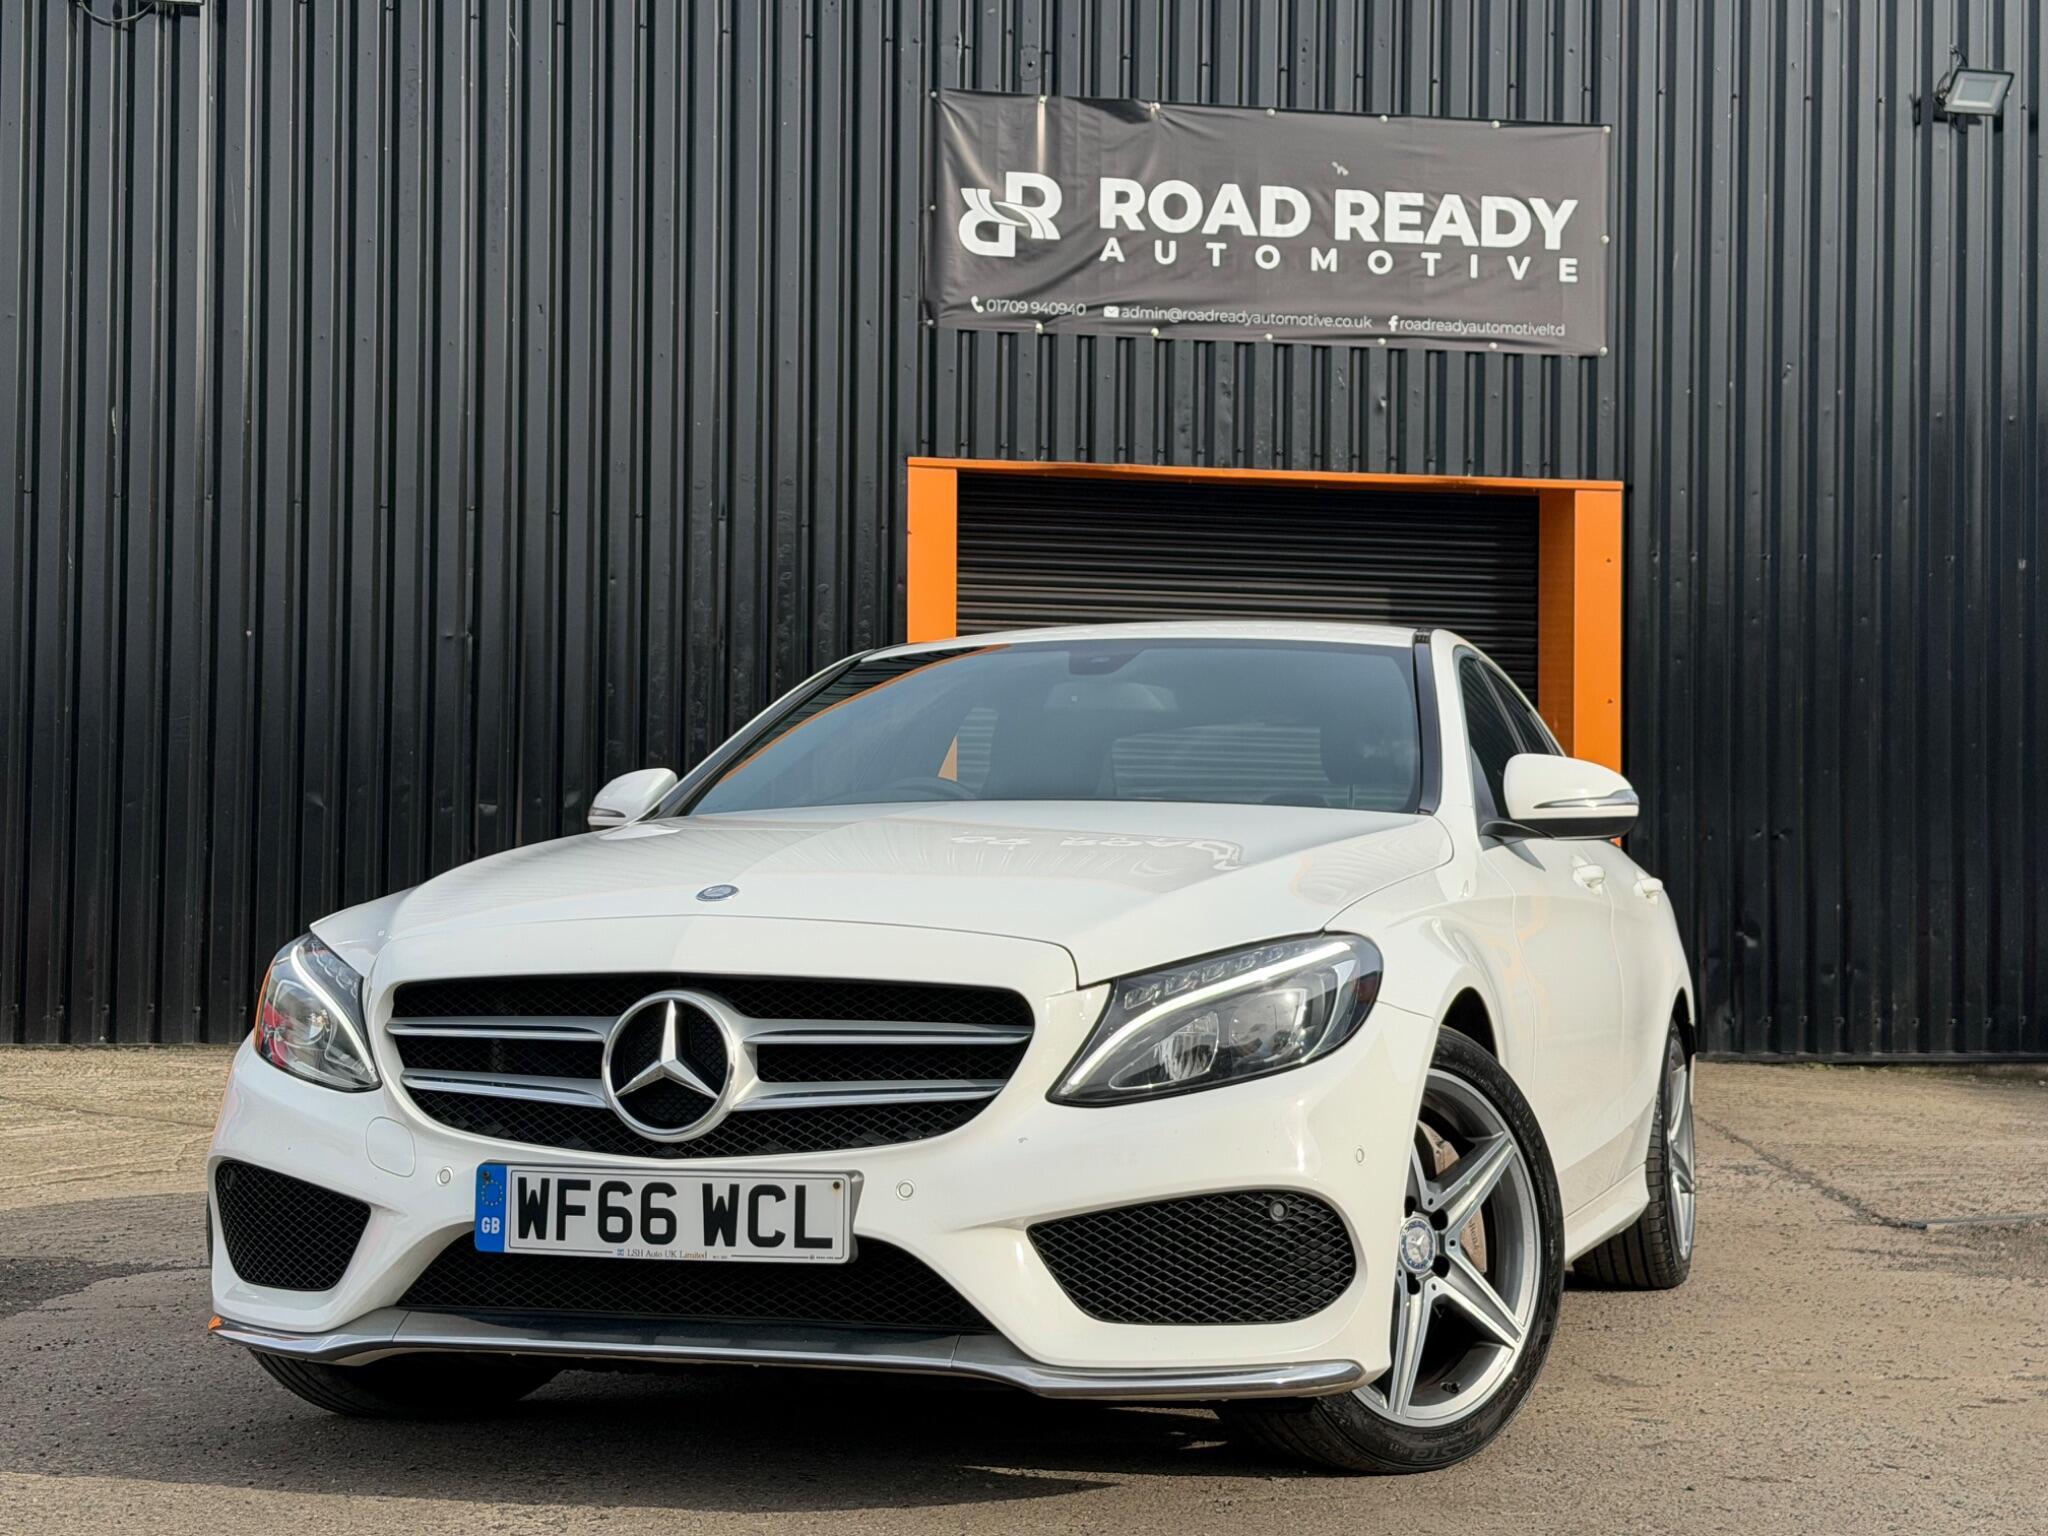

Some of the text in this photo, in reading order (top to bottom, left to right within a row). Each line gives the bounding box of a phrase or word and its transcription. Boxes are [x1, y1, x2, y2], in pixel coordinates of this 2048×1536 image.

[1099, 176, 1579, 251] ROAD READY
[1099, 236, 1579, 283] AUTOMOTIVE
[986, 299, 1086, 317] 01709 940940
[1121, 305, 1373, 329] admin@roadreadyautomotive.co.uk
[1400, 317, 1566, 337] roadreadyautomotiveltd
[517, 1176, 834, 1250] WF66 WCL
[481, 1216, 501, 1234] GB
[627, 1248, 644, 1257] LSH
[646, 1249, 663, 1258] Auto
[665, 1249, 678, 1259] UK
[680, 1249, 708, 1260] Limited
